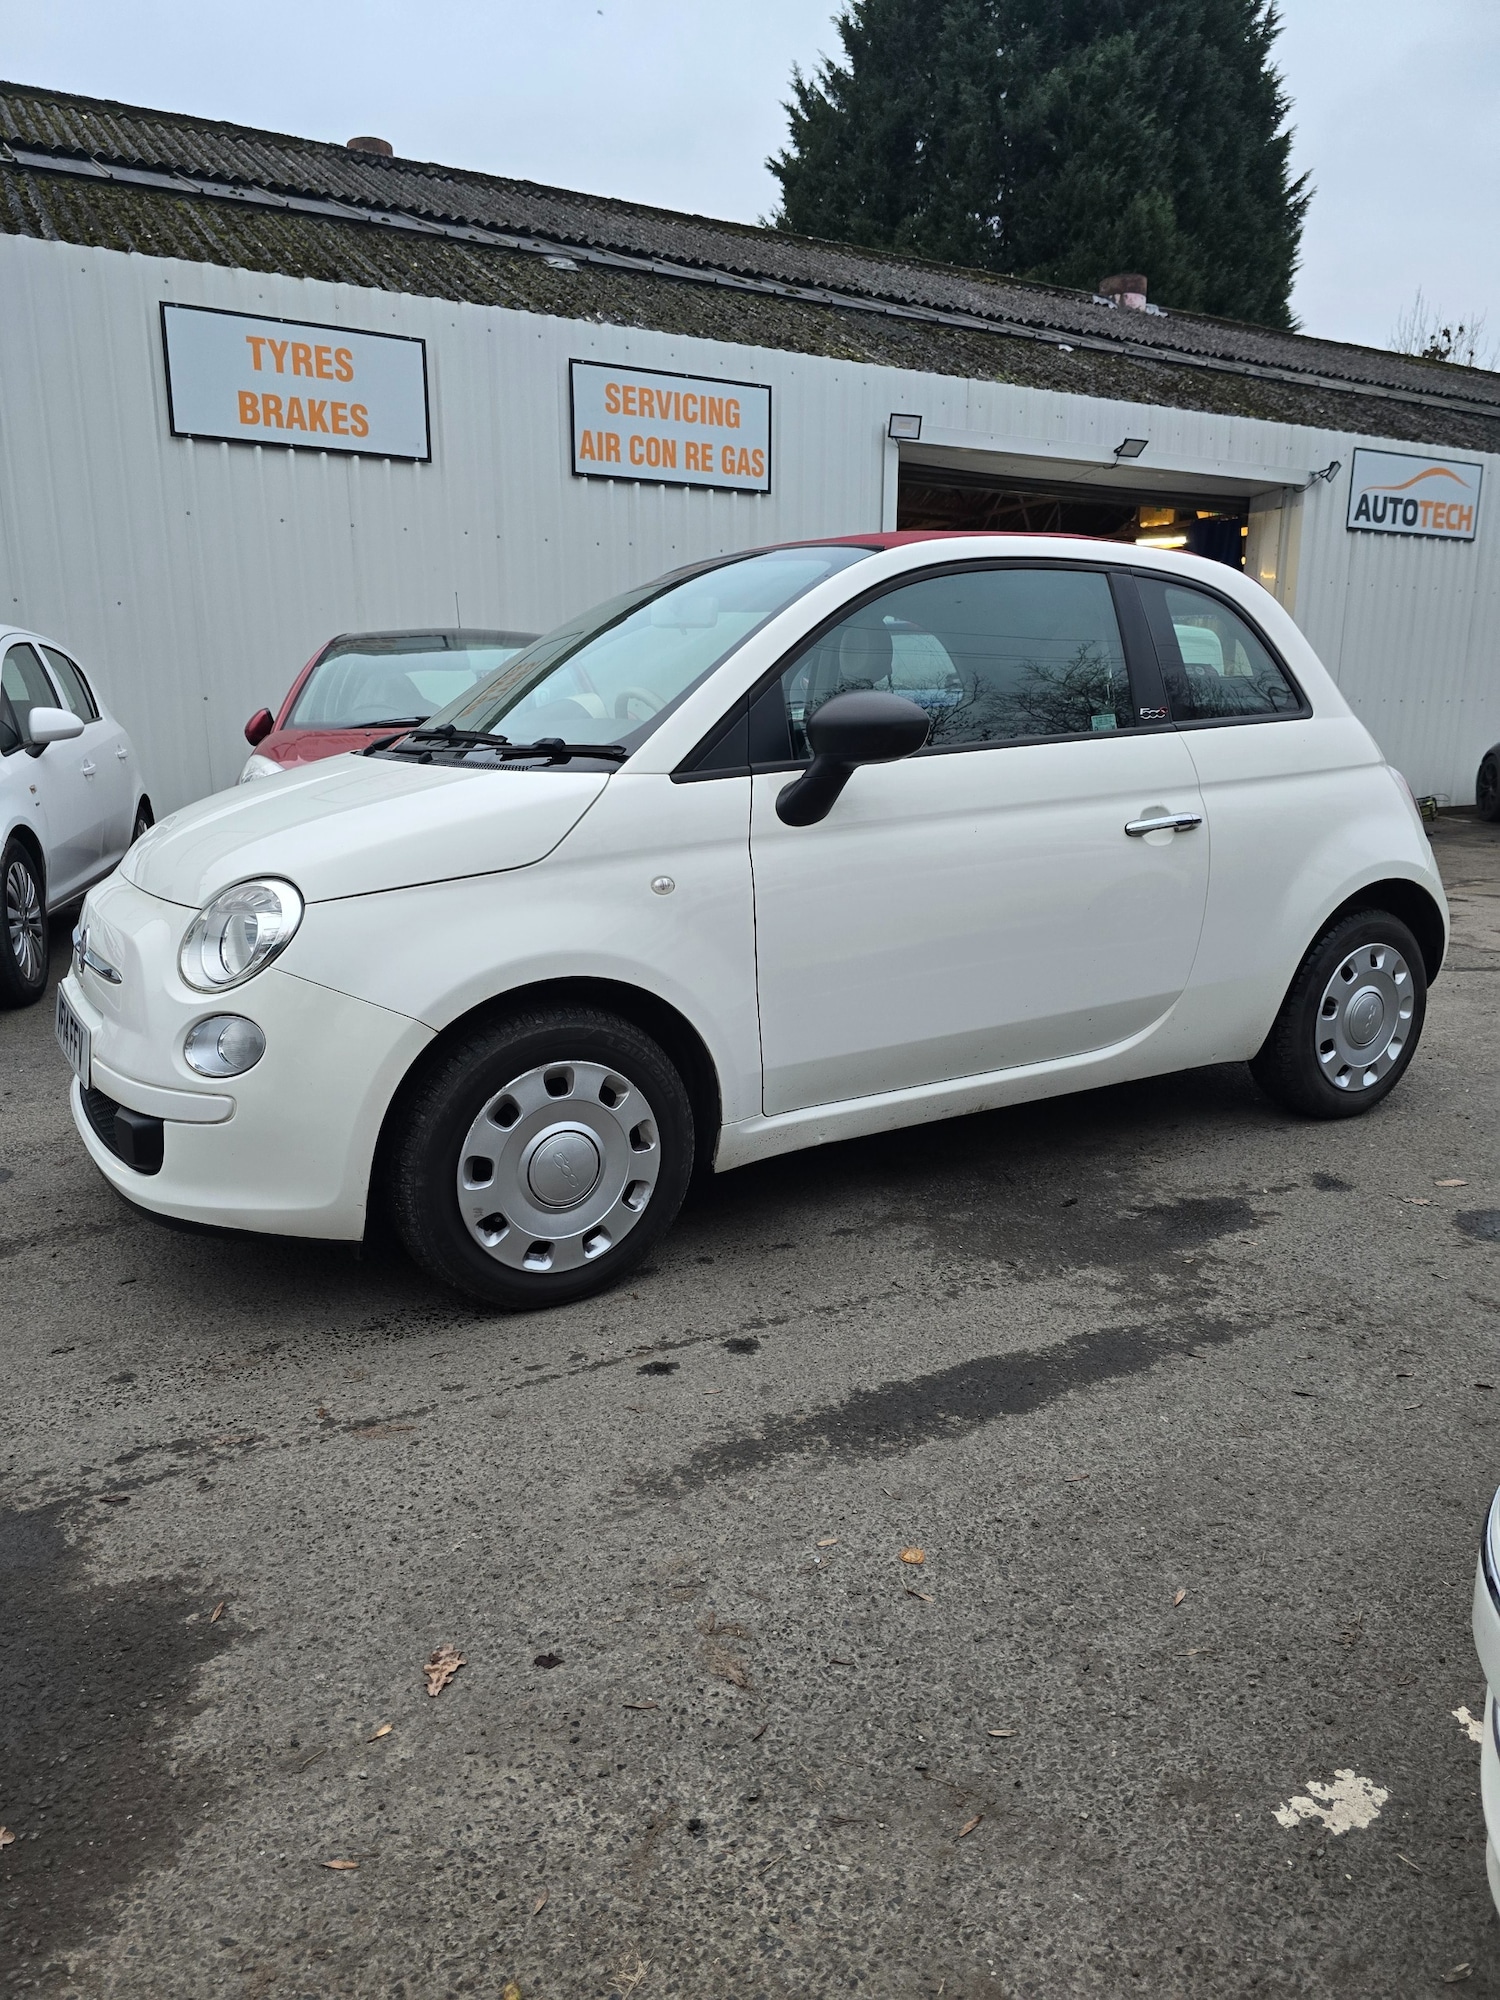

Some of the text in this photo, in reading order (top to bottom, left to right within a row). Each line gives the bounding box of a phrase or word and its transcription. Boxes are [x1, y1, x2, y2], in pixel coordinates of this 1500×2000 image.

[245, 335, 355, 383] TYRES
[237, 389, 370, 438] BRAKES
[605, 382, 741, 429] SERVICING
[579, 429, 765, 478] AIR CON RE GAS
[1354, 493, 1474, 533] AUTOTECH
